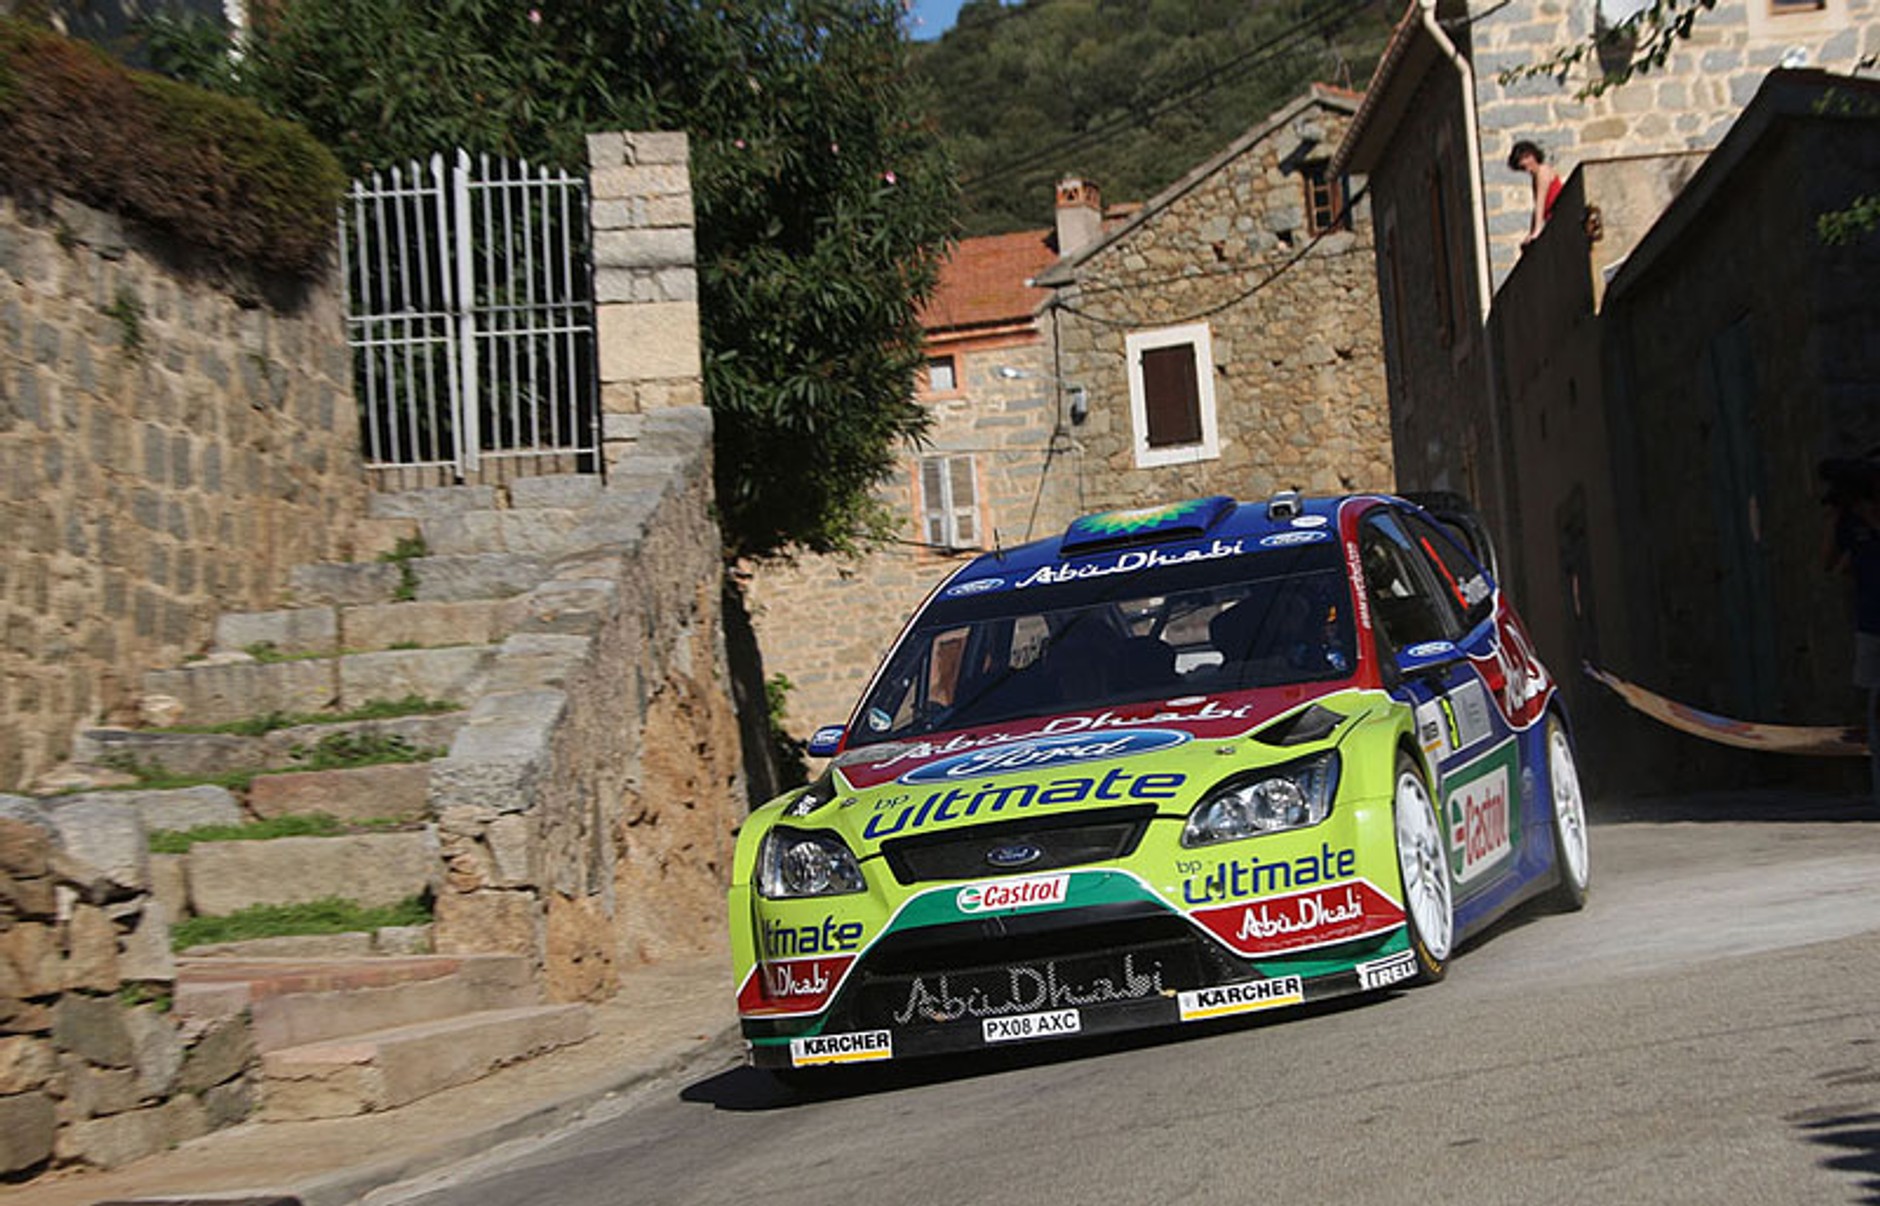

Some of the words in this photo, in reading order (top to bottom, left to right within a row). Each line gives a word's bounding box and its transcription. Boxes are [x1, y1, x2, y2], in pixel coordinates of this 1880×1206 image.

[1015, 562, 1101, 588] Abu
[1116, 541, 1244, 573] Dhabi
[872, 734, 1013, 769] Abu
[1043, 701, 1253, 736] Dhabi
[947, 734, 1139, 777] Ford
[863, 768, 1187, 839] ultimate
[874, 794, 911, 810] bp
[1176, 860, 1202, 874] bp
[1183, 843, 1355, 904] ultimate
[984, 879, 1060, 906] Castrol
[1236, 906, 1294, 939] Abu
[1298, 888, 1363, 930] Dhabi
[774, 962, 830, 997] Dhabi
[893, 976, 996, 1024] Abu
[1007, 953, 1164, 1013] Dhabi
[986, 1018, 1033, 1037] PX08
[1037, 1013, 1076, 1033] AXC
